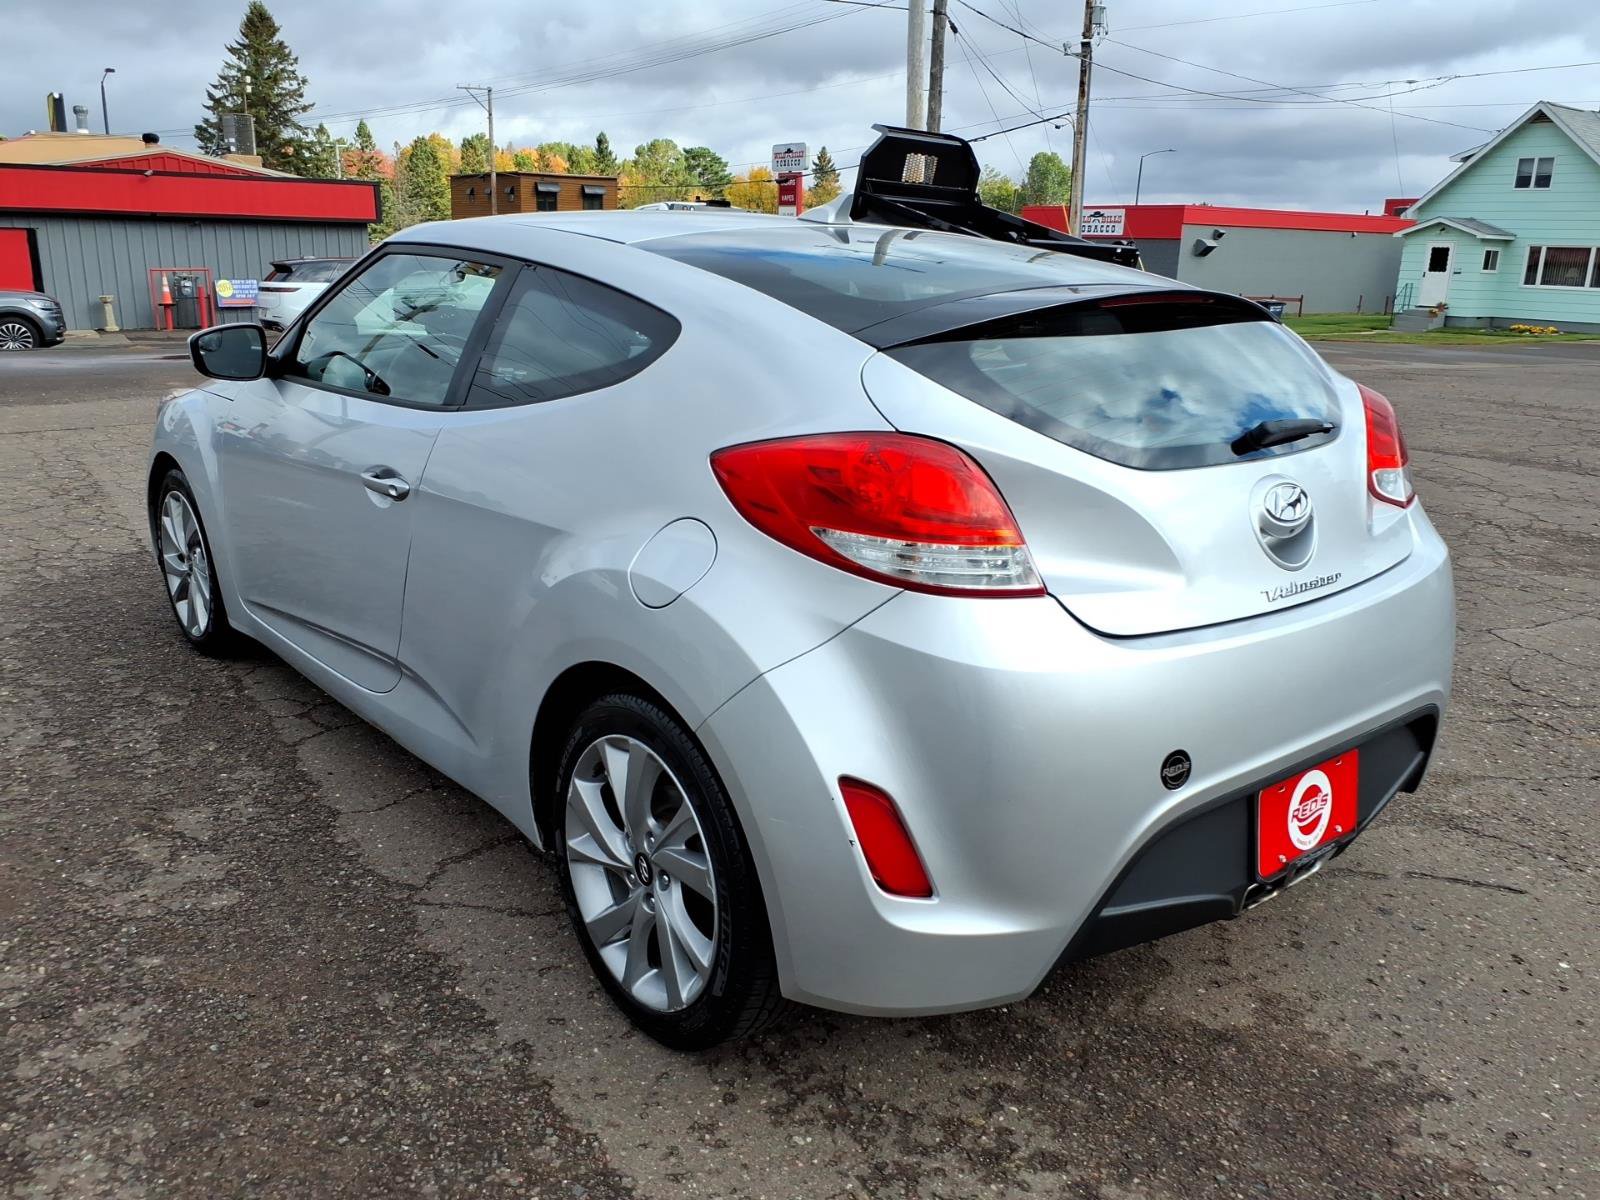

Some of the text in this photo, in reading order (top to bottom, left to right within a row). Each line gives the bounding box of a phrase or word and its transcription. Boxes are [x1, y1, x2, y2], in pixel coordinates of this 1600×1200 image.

[776, 159, 801, 167] TOBACCO
[1101, 215, 1122, 224] BILLS
[1081, 224, 1116, 233] OBACCO
[1291, 792, 1329, 823] RED'S
